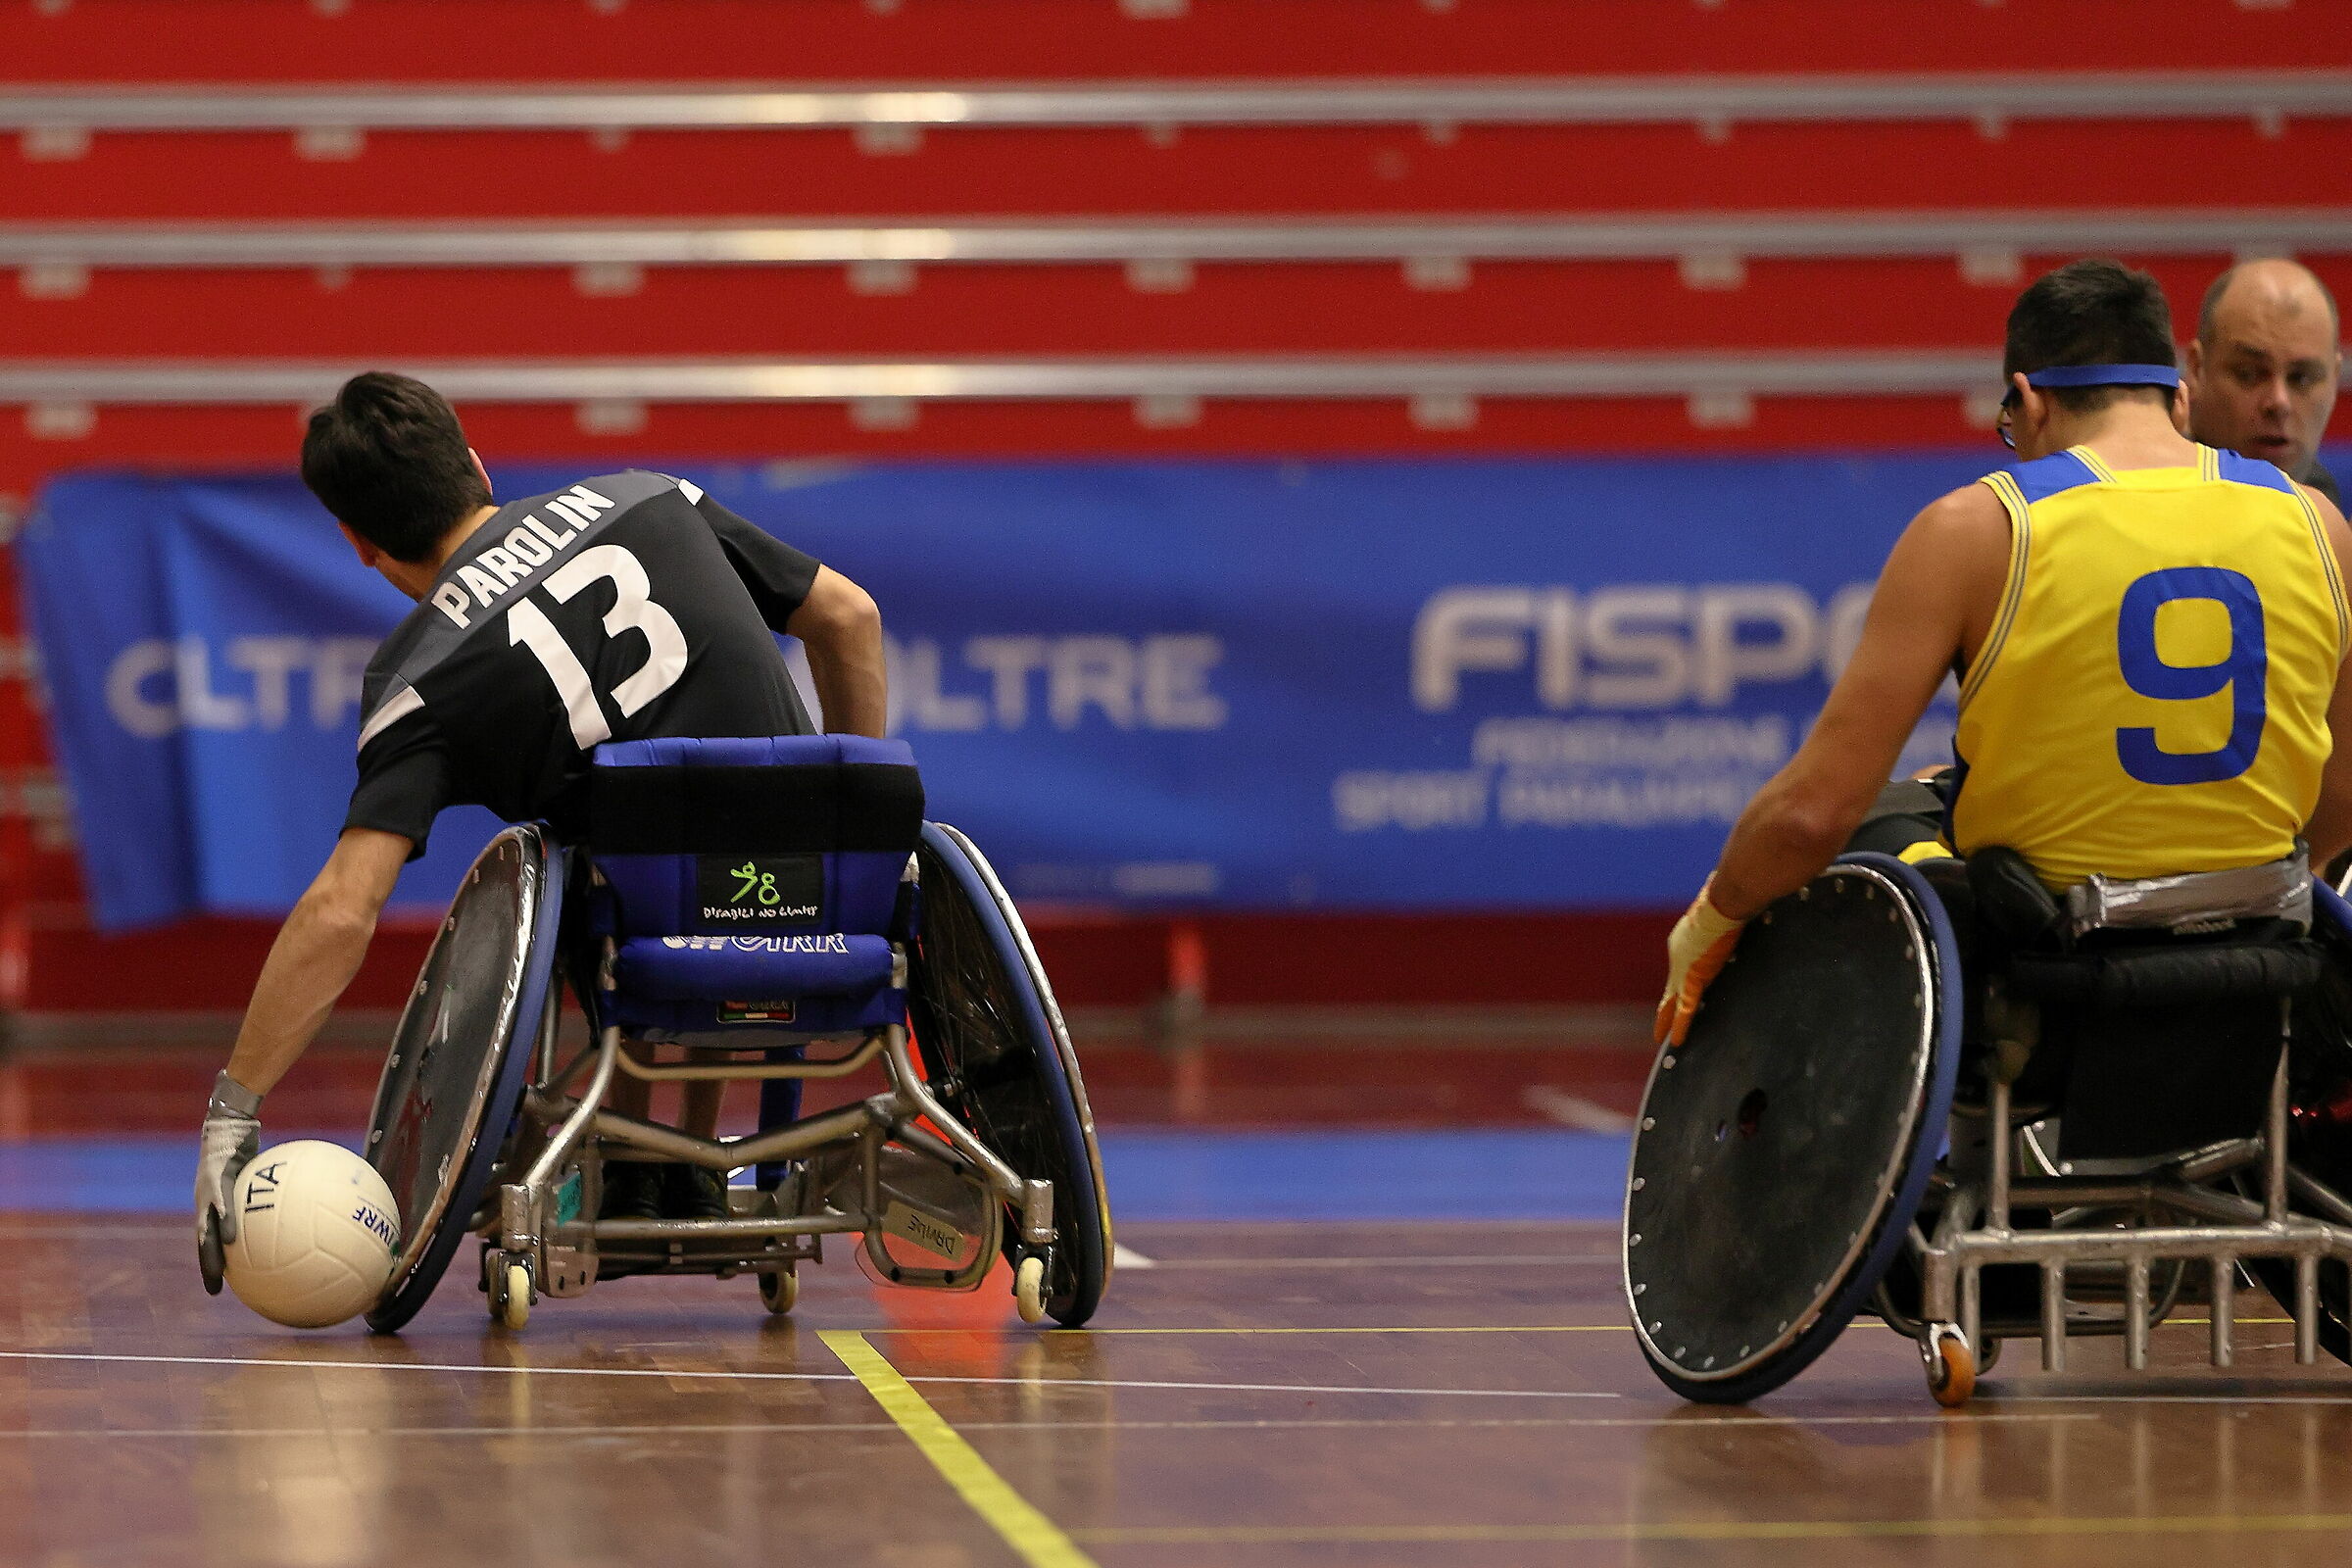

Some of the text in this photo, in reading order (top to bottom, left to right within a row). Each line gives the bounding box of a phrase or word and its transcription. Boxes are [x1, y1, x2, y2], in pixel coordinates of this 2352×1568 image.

[431, 483, 616, 630] PAROLIN
[508, 544, 689, 751] 13
[1409, 582, 1876, 713] FISP
[2116, 566, 2267, 786] 9
[245, 1160, 287, 1213] ITA
